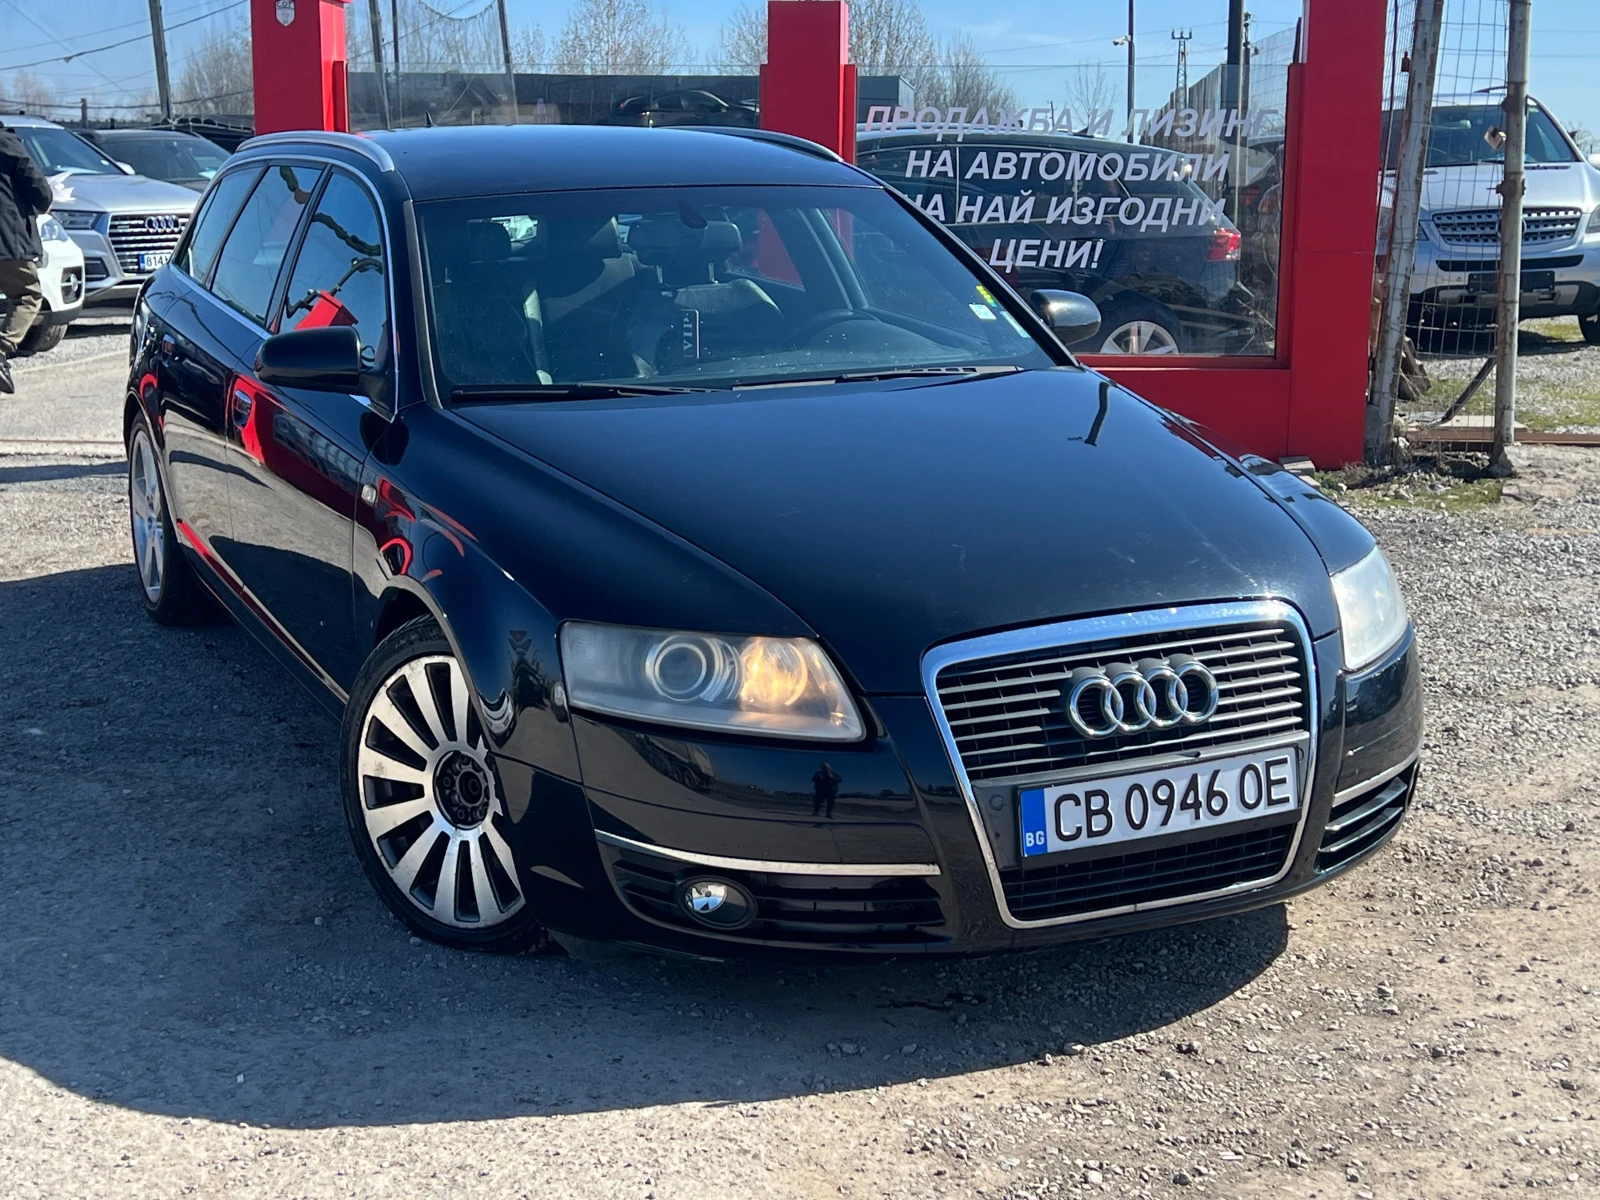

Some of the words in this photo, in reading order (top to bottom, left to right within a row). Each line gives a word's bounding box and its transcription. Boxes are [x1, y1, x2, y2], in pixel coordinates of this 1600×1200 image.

[864, 105, 1074, 142] ПРОДАЖБА
[1086, 108, 1114, 136] И
[1121, 108, 1279, 137] ЛИЗИНГ
[905, 150, 955, 178] НА
[964, 151, 1230, 182] АВТОМОБИЛИ
[957, 189, 1036, 224] НАЙ
[1045, 196, 1227, 233] ИЗГОДНИ
[989, 238, 1104, 274] ЦЕНИ!
[1053, 788, 1113, 842] CB
[1125, 769, 1229, 831] 0946
[1239, 756, 1291, 810] OE
[1025, 830, 1045, 847] BG
